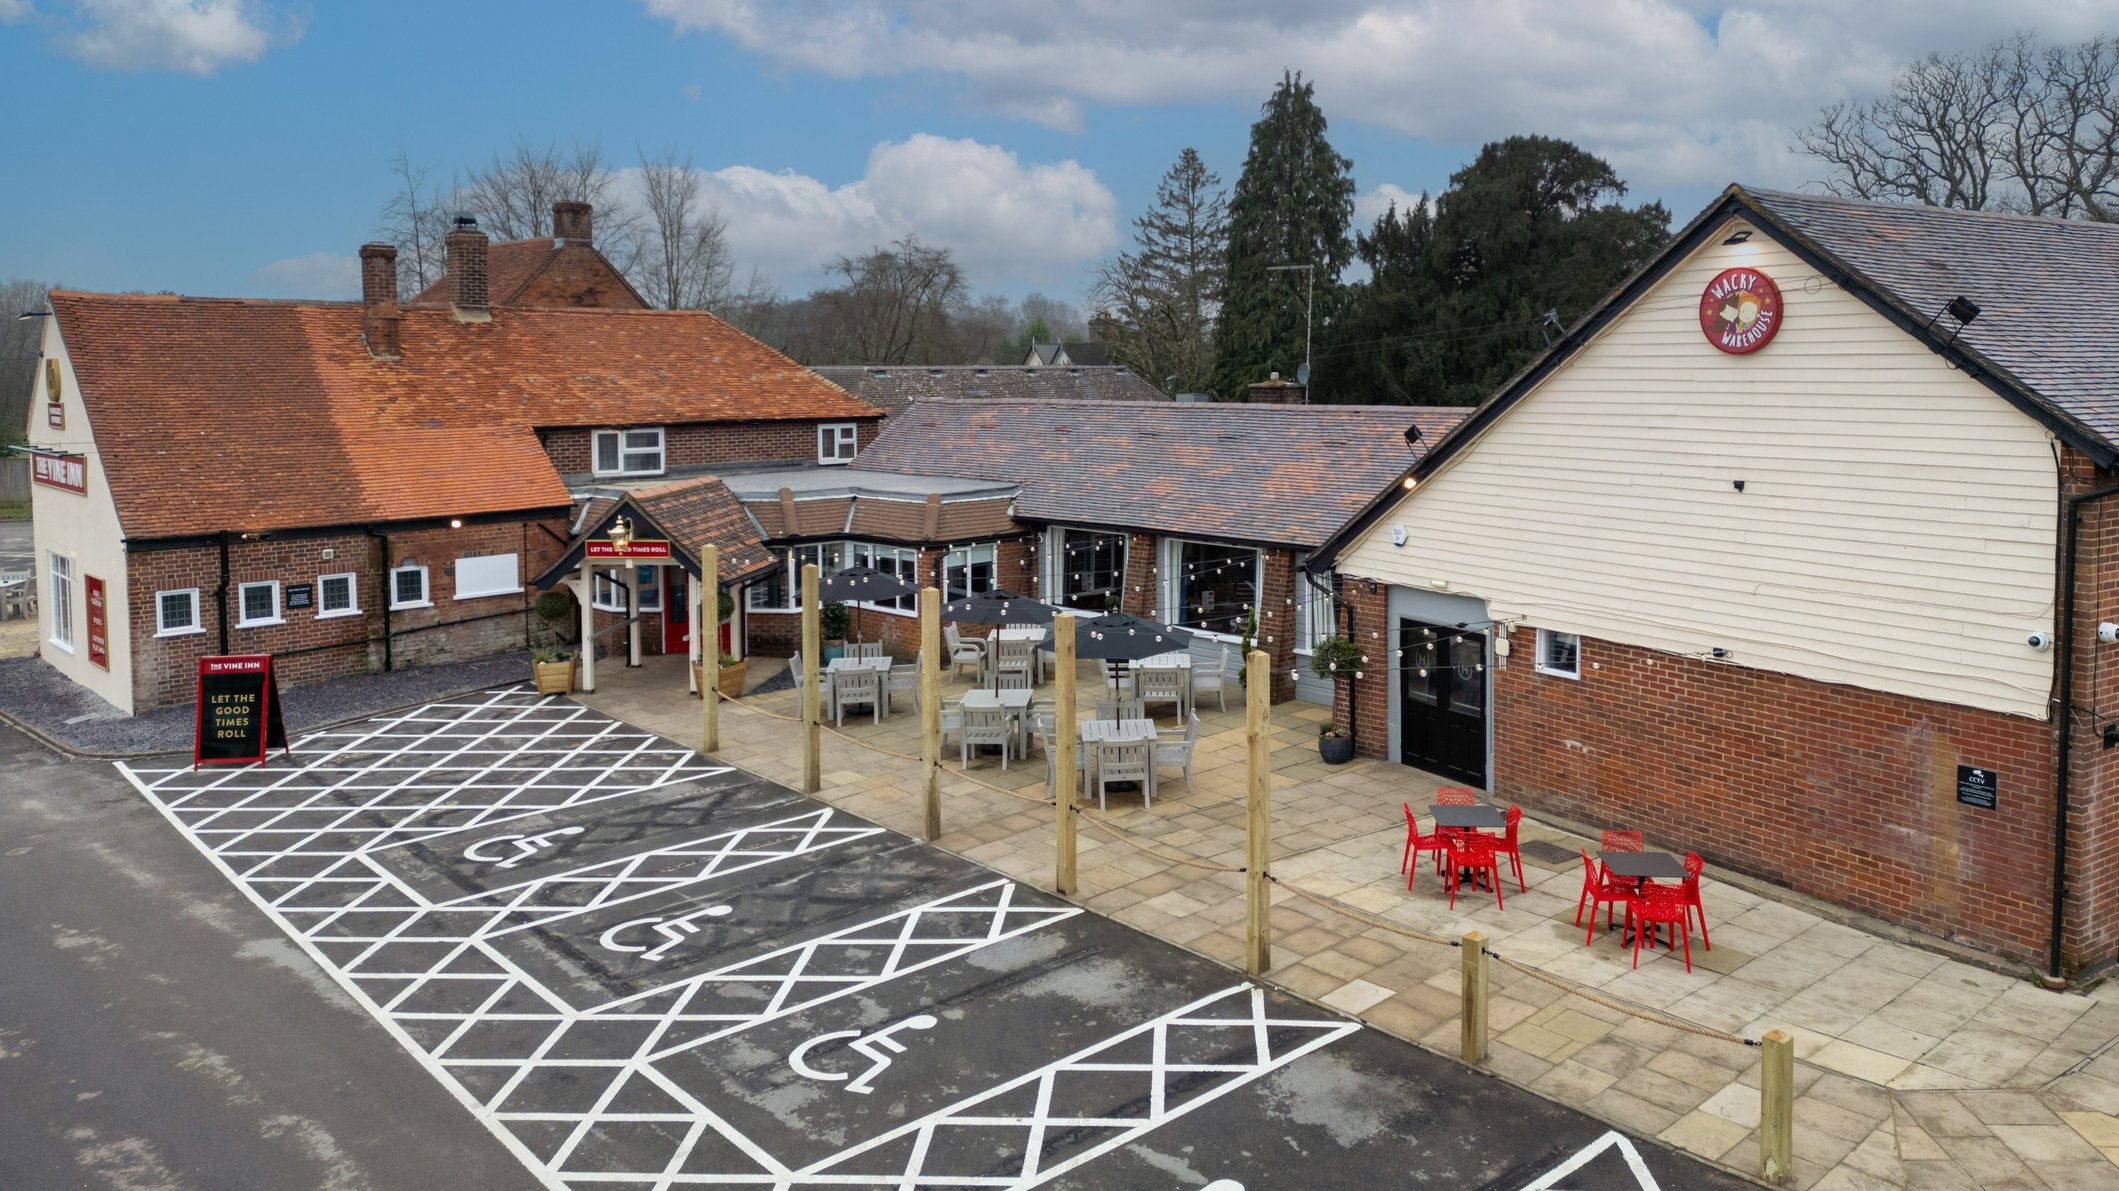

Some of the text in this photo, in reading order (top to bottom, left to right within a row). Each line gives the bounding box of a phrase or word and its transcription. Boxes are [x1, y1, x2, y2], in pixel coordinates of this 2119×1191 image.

[1711, 273, 1756, 299] WACKY
[1721, 309, 1773, 347] WAREHOUSE
[47, 458, 66, 484] VINE
[66, 462, 83, 488] INN
[211, 694, 255, 704] LET THE
[215, 706, 250, 715] GOOD
[215, 718, 249, 727] TIMES
[217, 730, 246, 738] ROLL
[1969, 776, 1984, 784] CCTV
